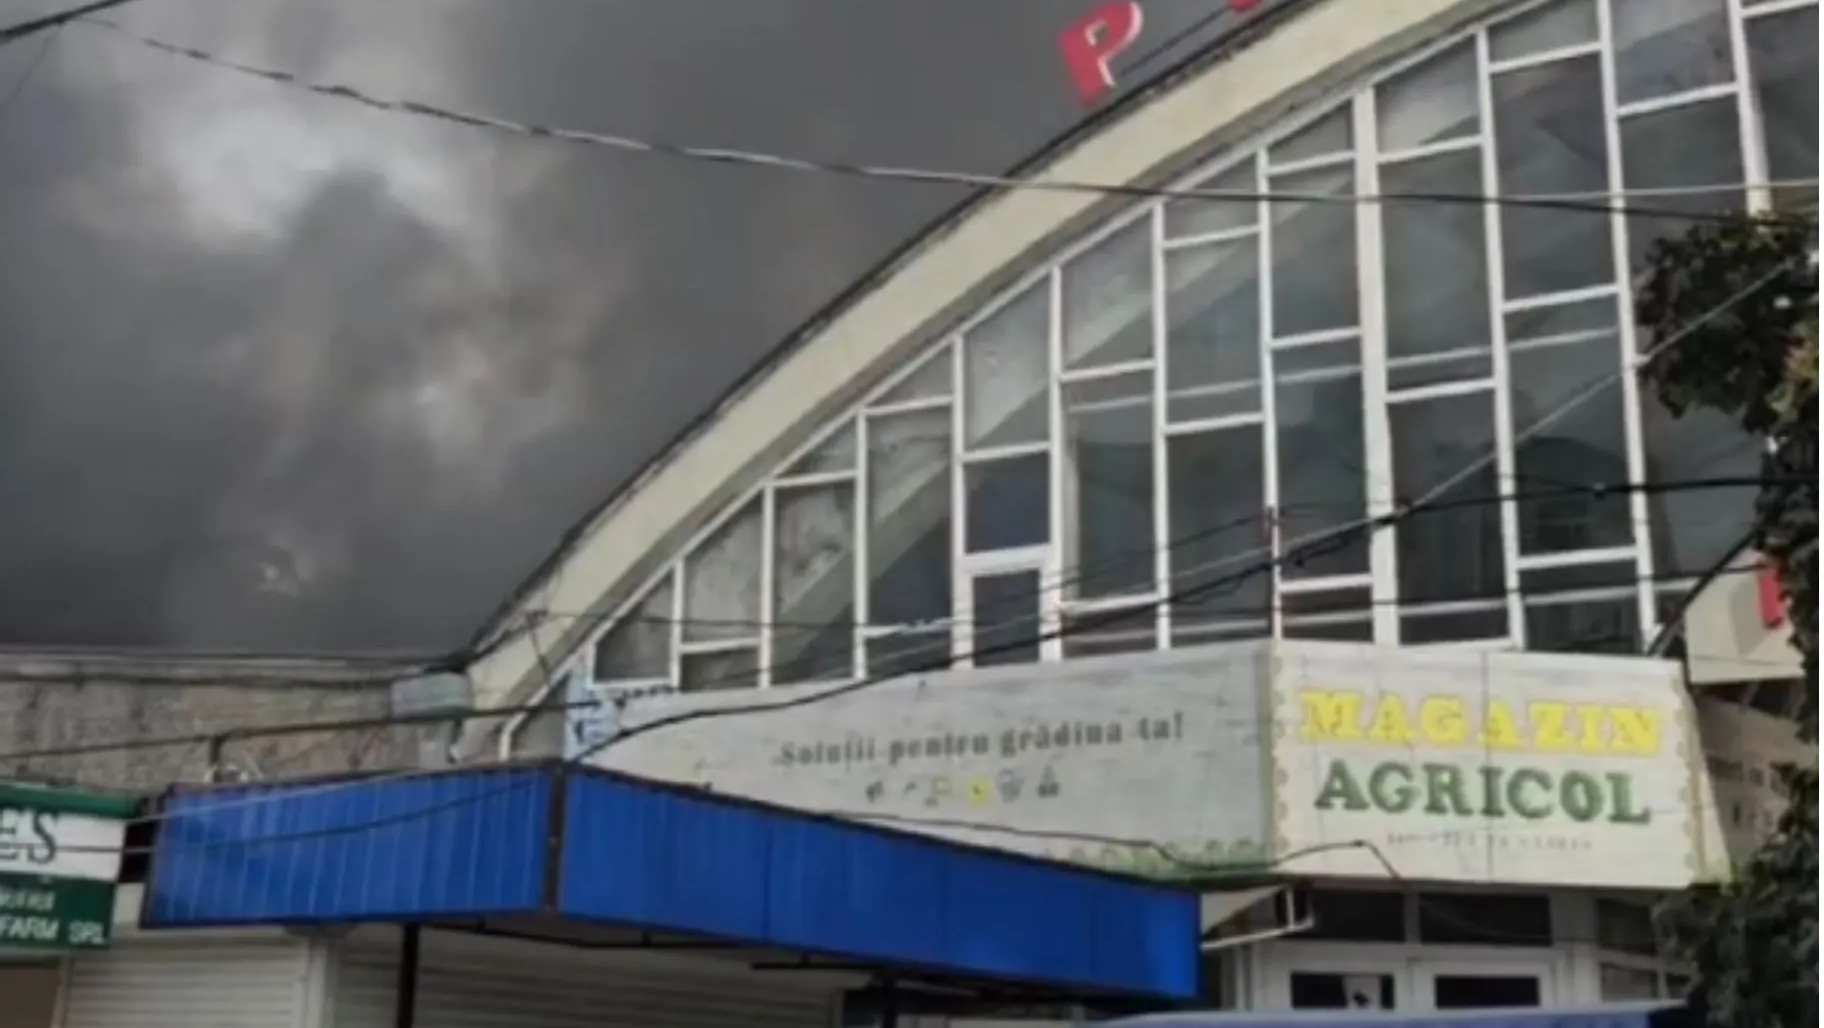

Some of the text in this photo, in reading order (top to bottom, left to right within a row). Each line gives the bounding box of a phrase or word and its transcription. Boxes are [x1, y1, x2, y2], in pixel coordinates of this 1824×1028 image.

[888, 731, 989, 766] pentru
[1136, 711, 1183, 741] ta!
[1300, 689, 1663, 755] MAGAZIN
[1314, 759, 1651, 825] AGRICOL
